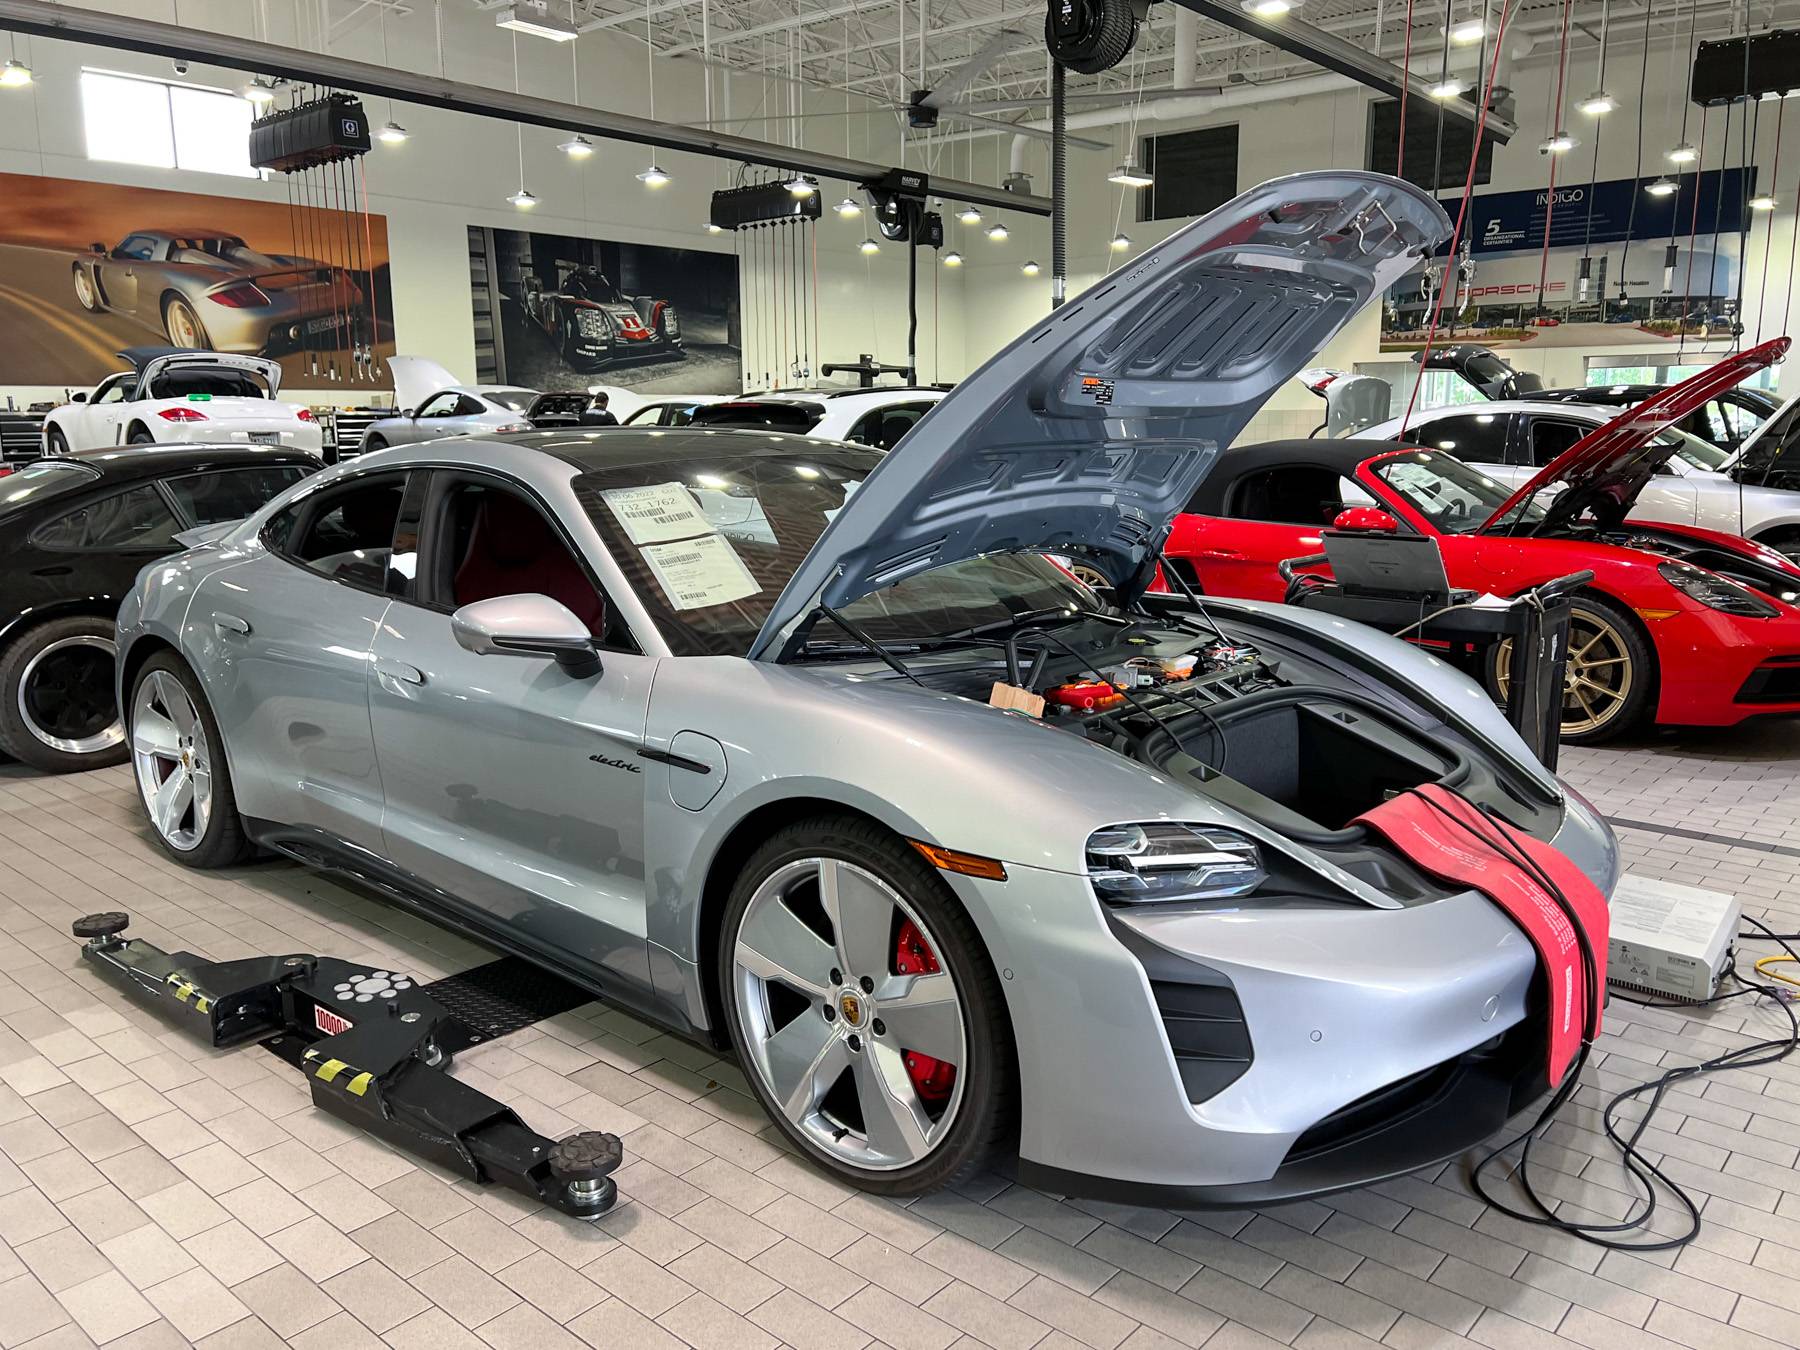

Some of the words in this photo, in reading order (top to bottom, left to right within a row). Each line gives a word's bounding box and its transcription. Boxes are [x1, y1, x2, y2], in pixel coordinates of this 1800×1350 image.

[1536, 189, 1584, 206] INDIGO
[1485, 219, 1501, 236] 5
[1483, 233, 1525, 241] ORGANIZATIONAL
[625, 318, 637, 328] 1
[589, 754, 641, 773] electric
